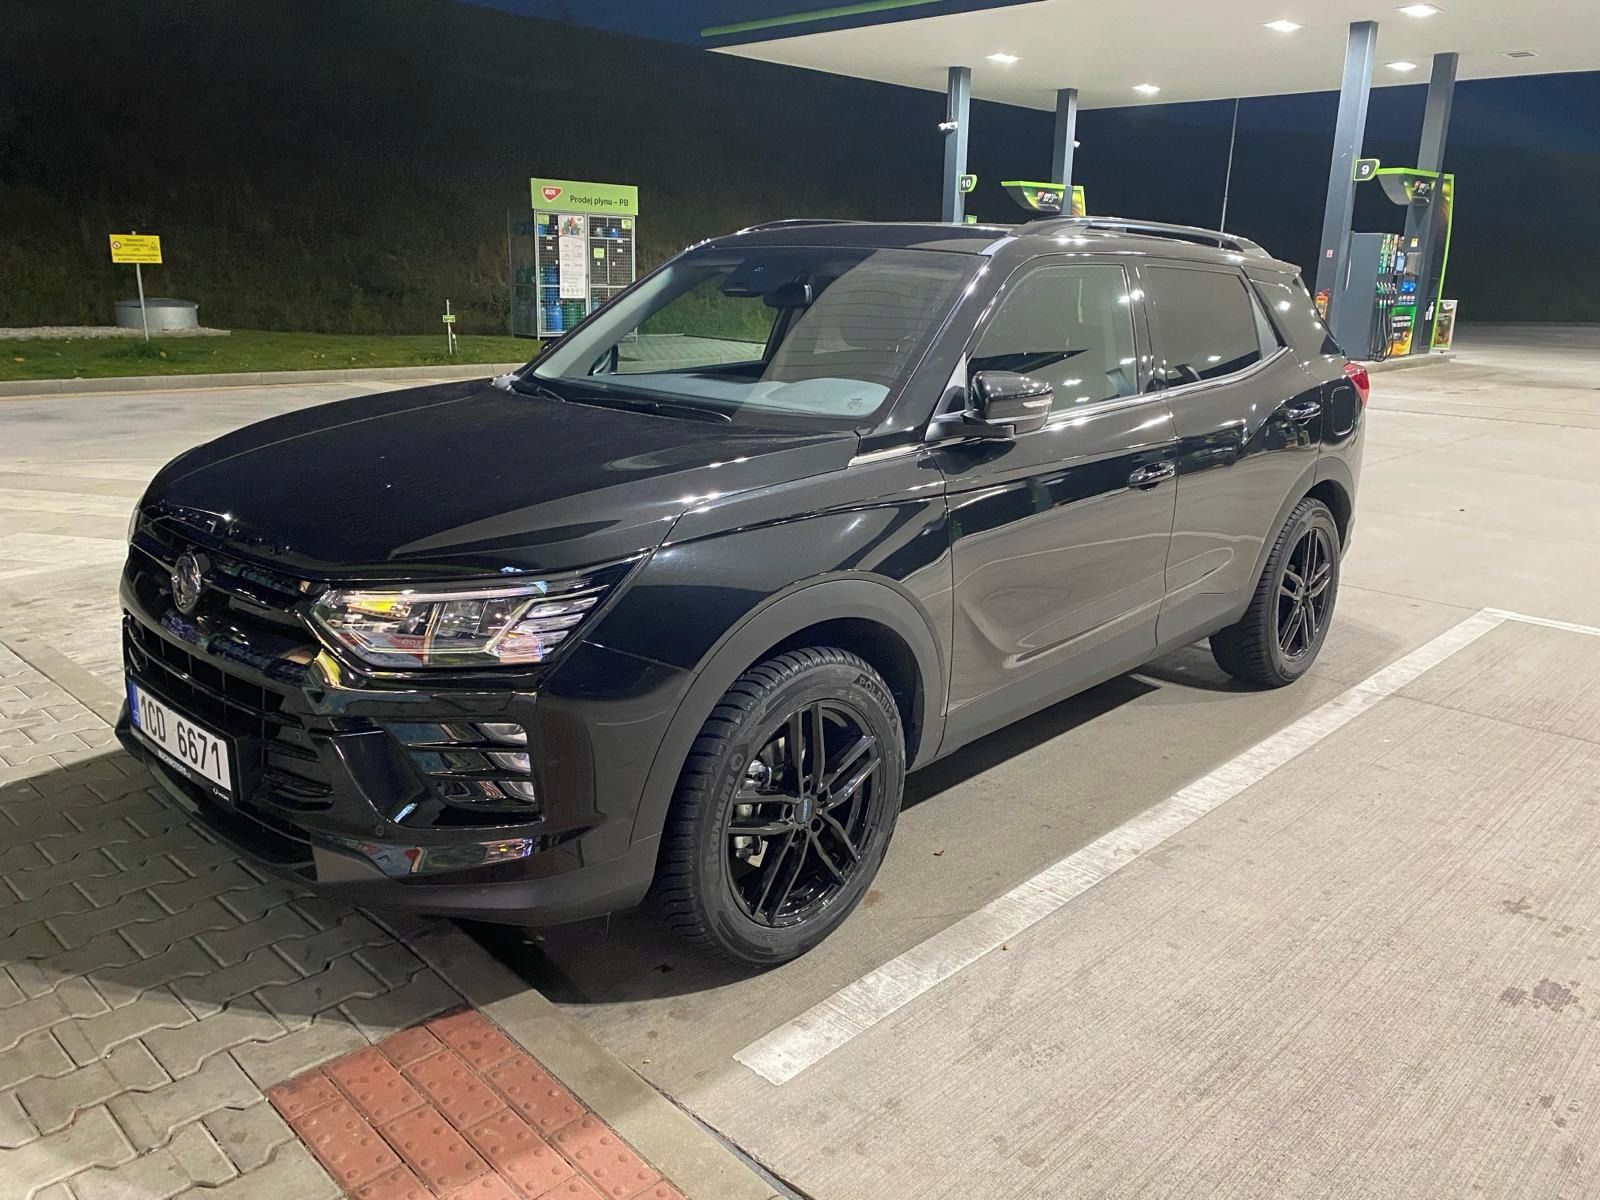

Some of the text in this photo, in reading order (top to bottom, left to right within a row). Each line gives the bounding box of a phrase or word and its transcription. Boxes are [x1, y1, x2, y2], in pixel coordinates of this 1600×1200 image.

[1361, 165, 1370, 175] 9
[961, 179, 972, 188] 10
[570, 195, 593, 206] Prodej
[594, 198, 613, 206] plynu
[619, 199, 629, 207] PB
[859, 676, 893, 717] POLARIS
[140, 695, 166, 743] 1CD
[177, 721, 222, 780] 6671
